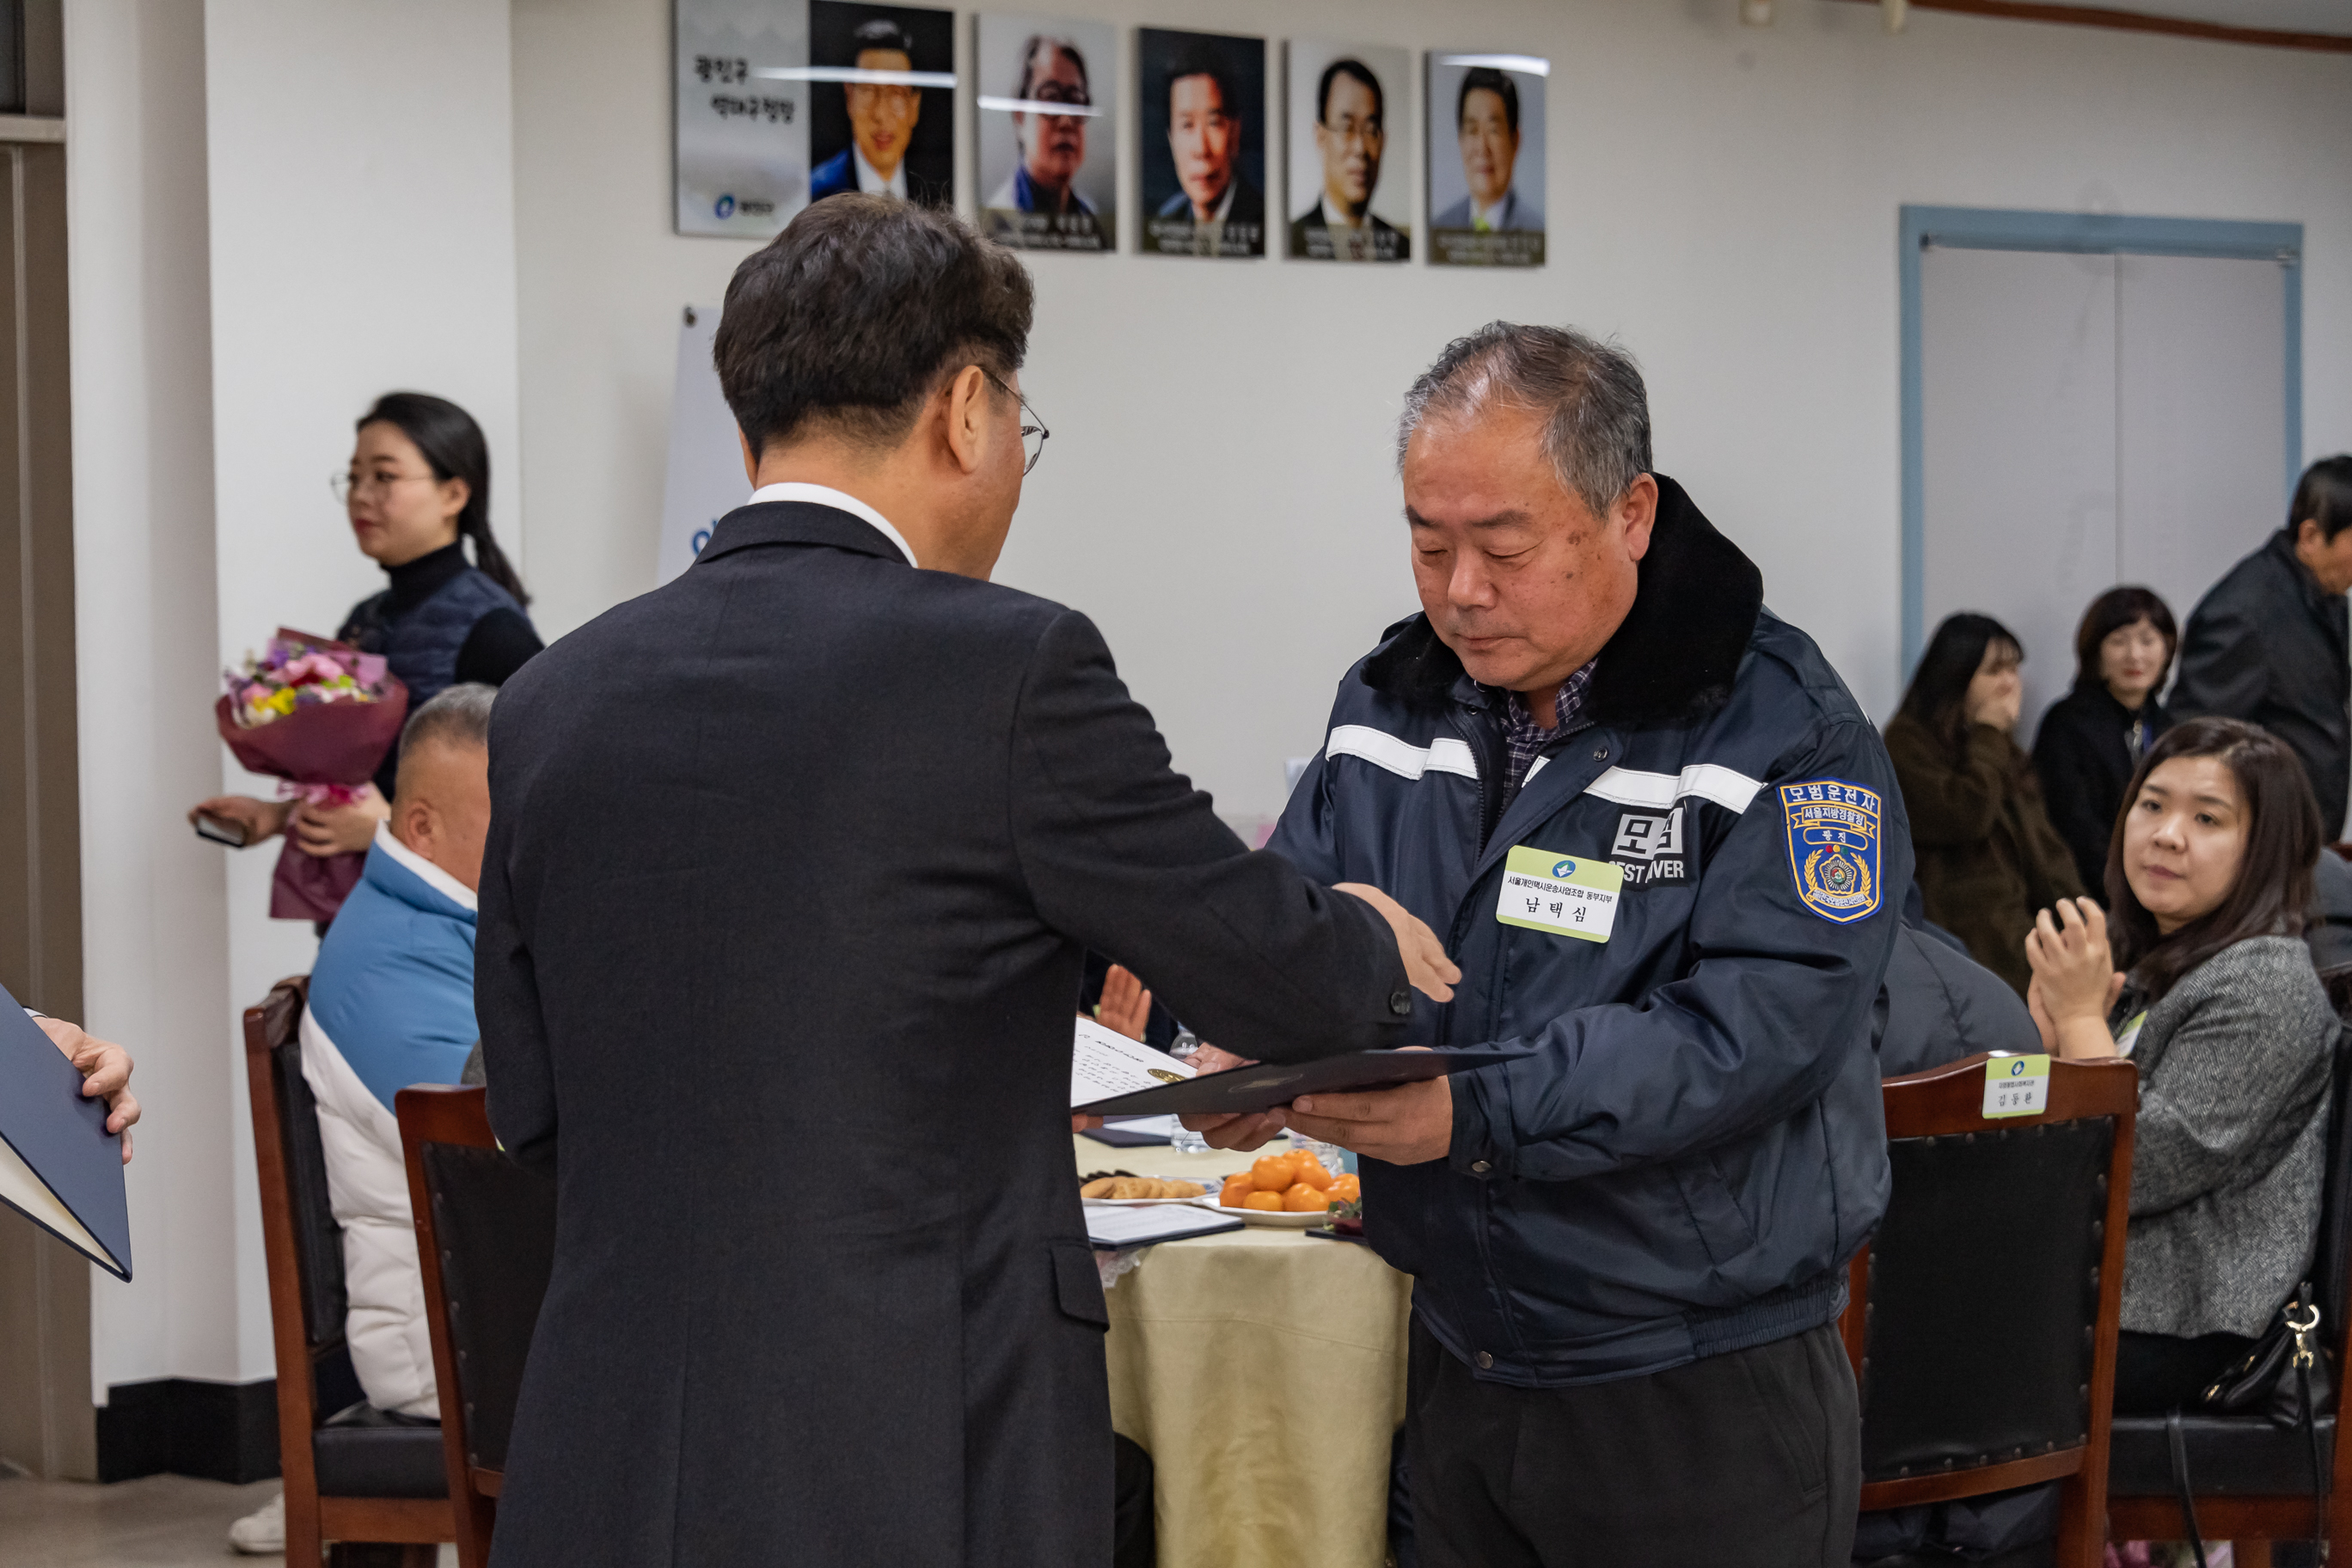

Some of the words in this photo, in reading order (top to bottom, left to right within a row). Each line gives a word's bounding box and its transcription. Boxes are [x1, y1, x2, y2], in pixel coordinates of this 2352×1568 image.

[1790, 784, 1875, 812] 모범운전자
[1805, 807, 1864, 825] 서울지방경찰청
[1508, 876, 1584, 898] 서울개인택시운송사업조합
[1586, 891, 1613, 903] 동부지부
